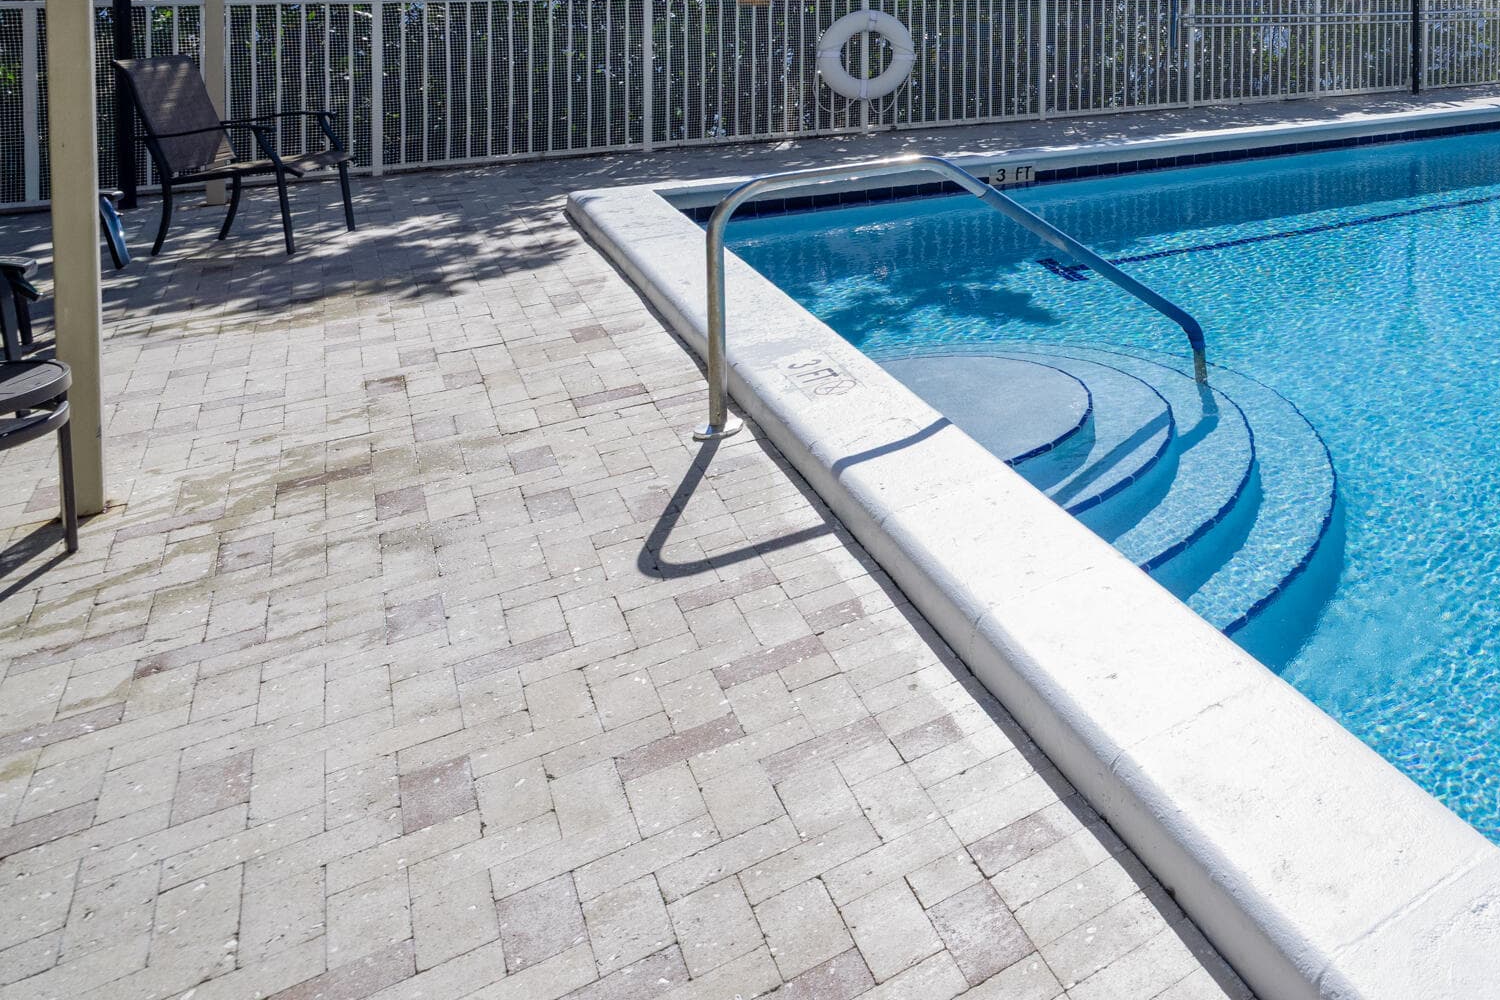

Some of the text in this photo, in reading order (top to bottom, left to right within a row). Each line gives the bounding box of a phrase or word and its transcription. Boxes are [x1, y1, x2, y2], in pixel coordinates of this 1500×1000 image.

[996, 166, 1032, 182] 3 FT
[788, 359, 839, 384] 3 FT
